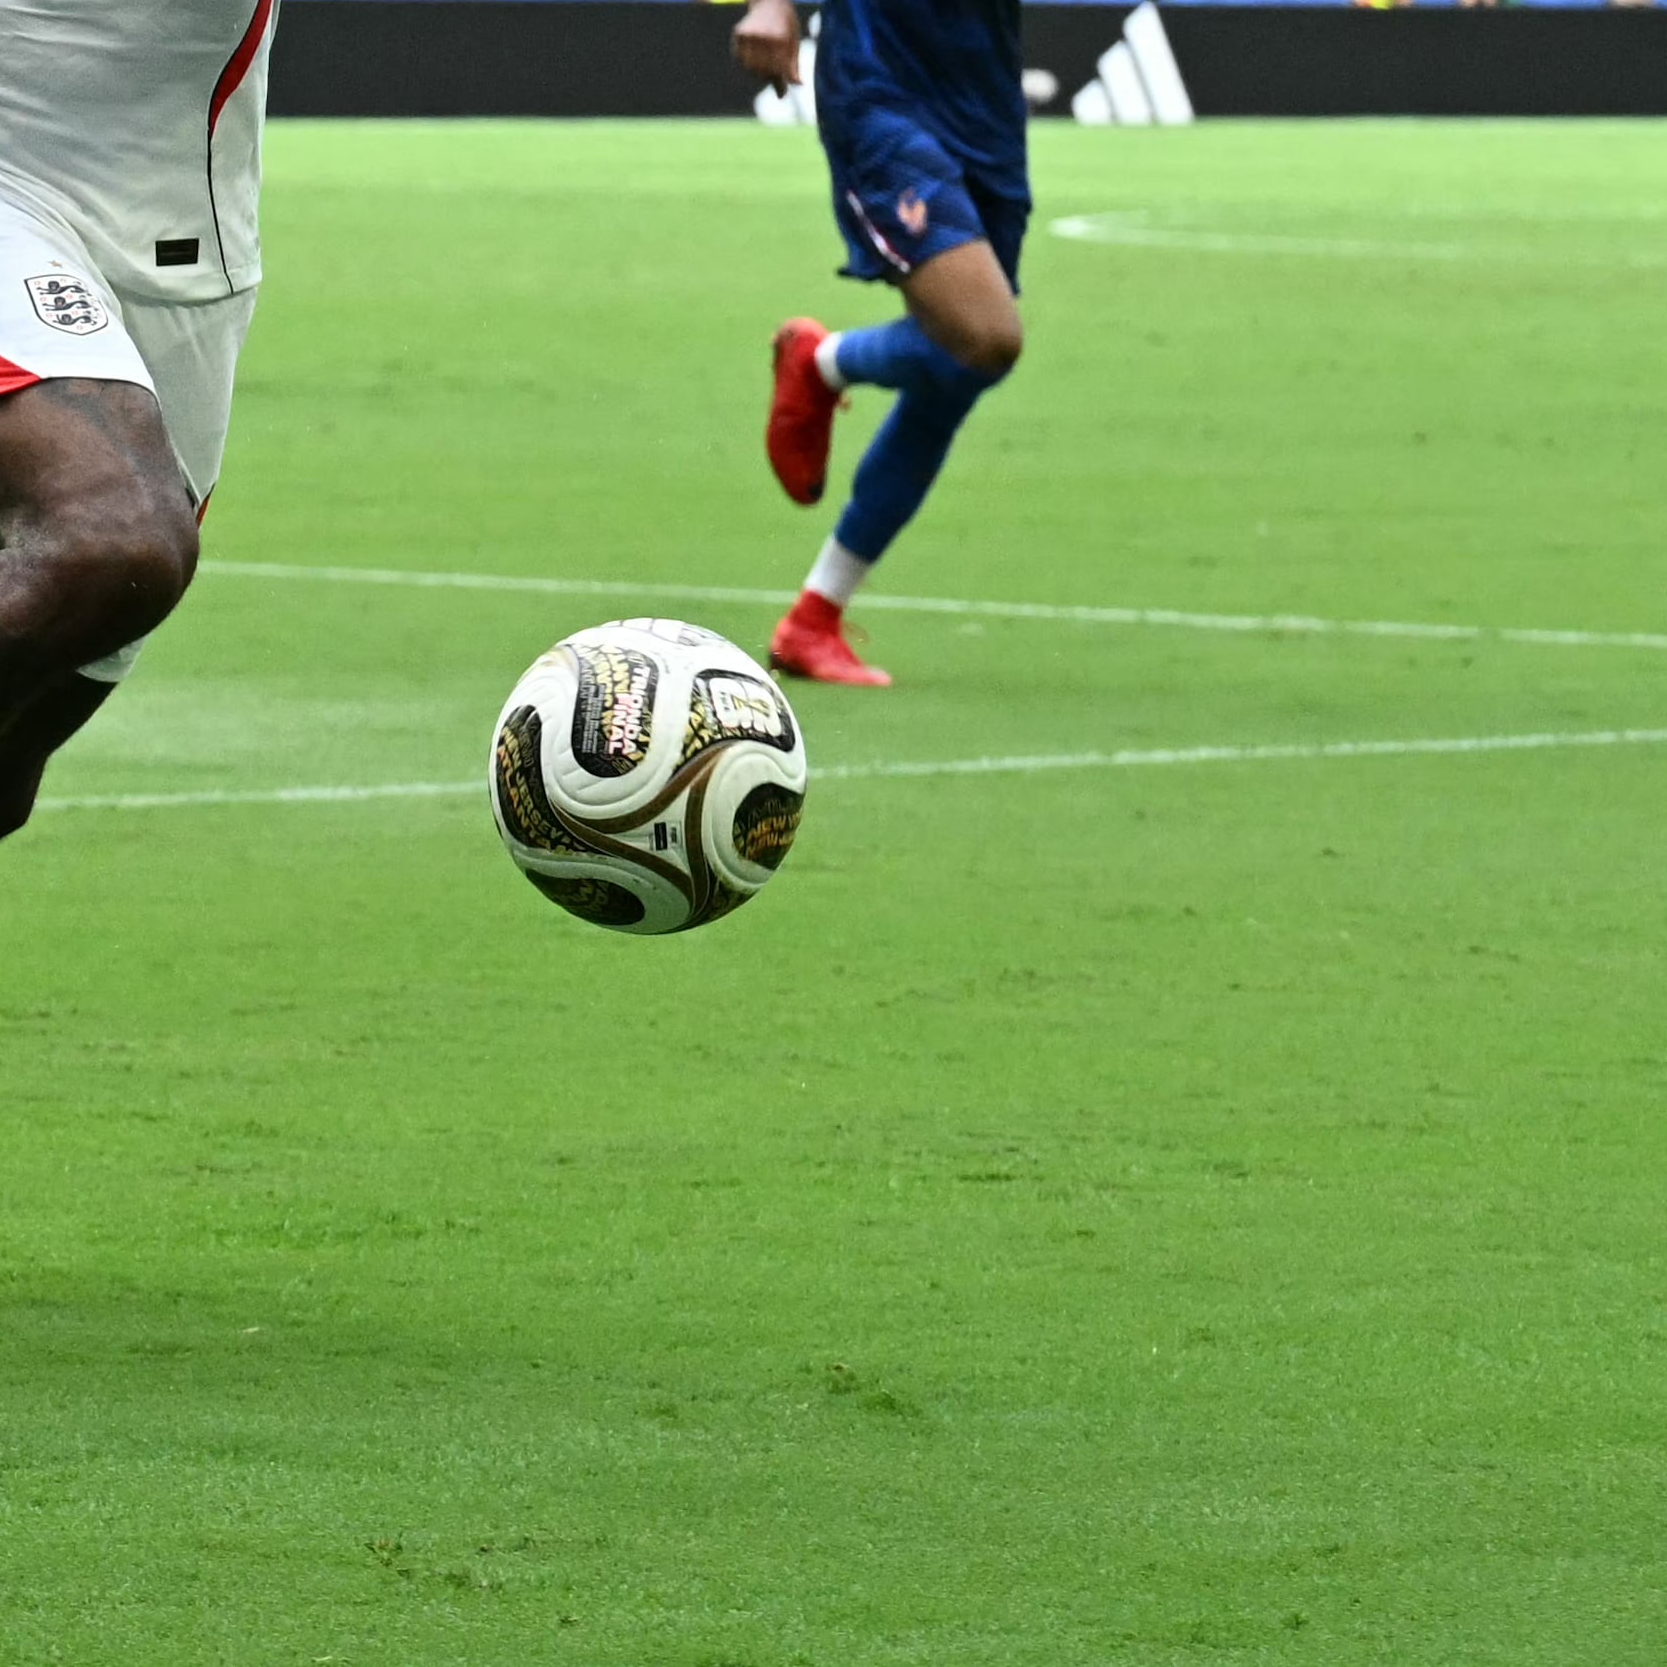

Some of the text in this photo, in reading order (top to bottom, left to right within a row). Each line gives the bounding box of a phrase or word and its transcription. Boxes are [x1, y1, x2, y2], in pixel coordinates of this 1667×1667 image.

[608, 694, 630, 754] FINAL
[621, 666, 651, 755] TRIONDA
[516, 771, 561, 839] JERSEY
